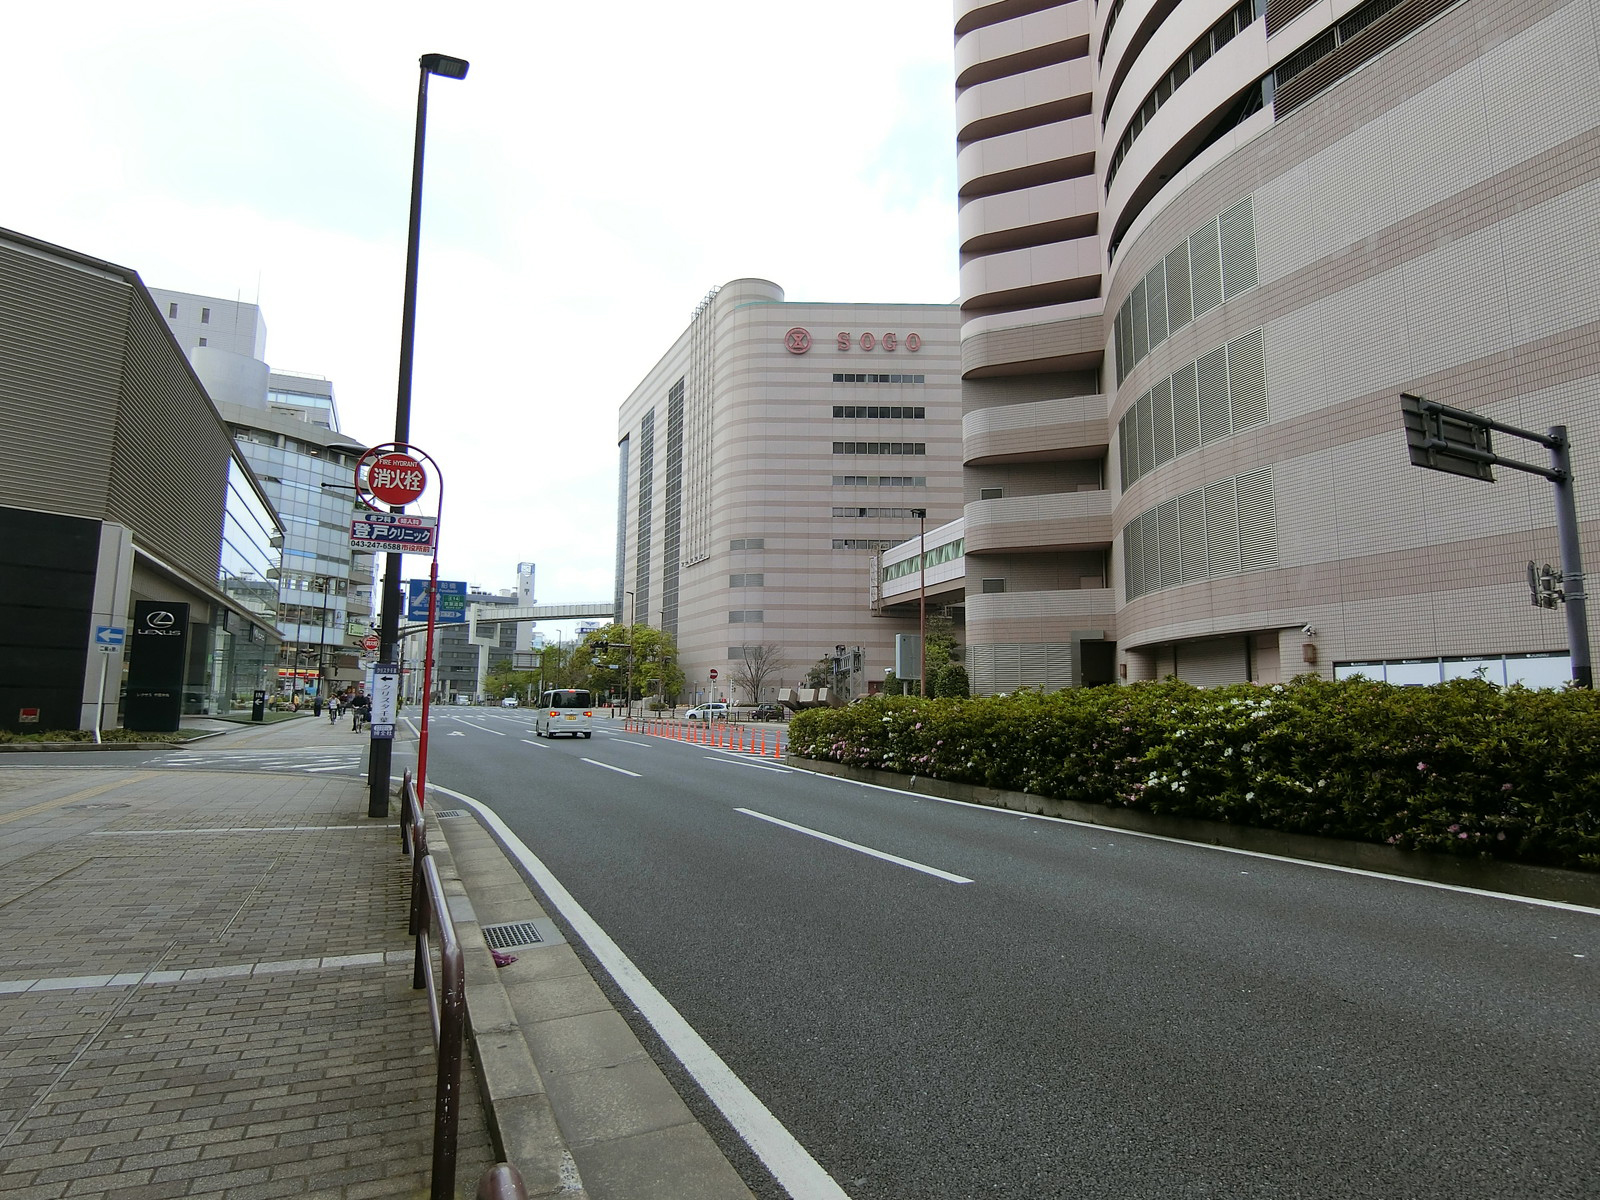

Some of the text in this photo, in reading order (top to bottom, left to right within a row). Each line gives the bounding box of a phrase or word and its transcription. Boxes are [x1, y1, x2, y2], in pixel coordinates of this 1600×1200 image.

[836, 331, 922, 352] SOGO
[392, 459, 418, 468] HYDRANT
[372, 467, 423, 491] 消火栓
[352, 522, 431, 543] 登戸クリニック
[350, 540, 430, 553] 043-247-6588 市役所前
[137, 628, 181, 636] LEXUS
